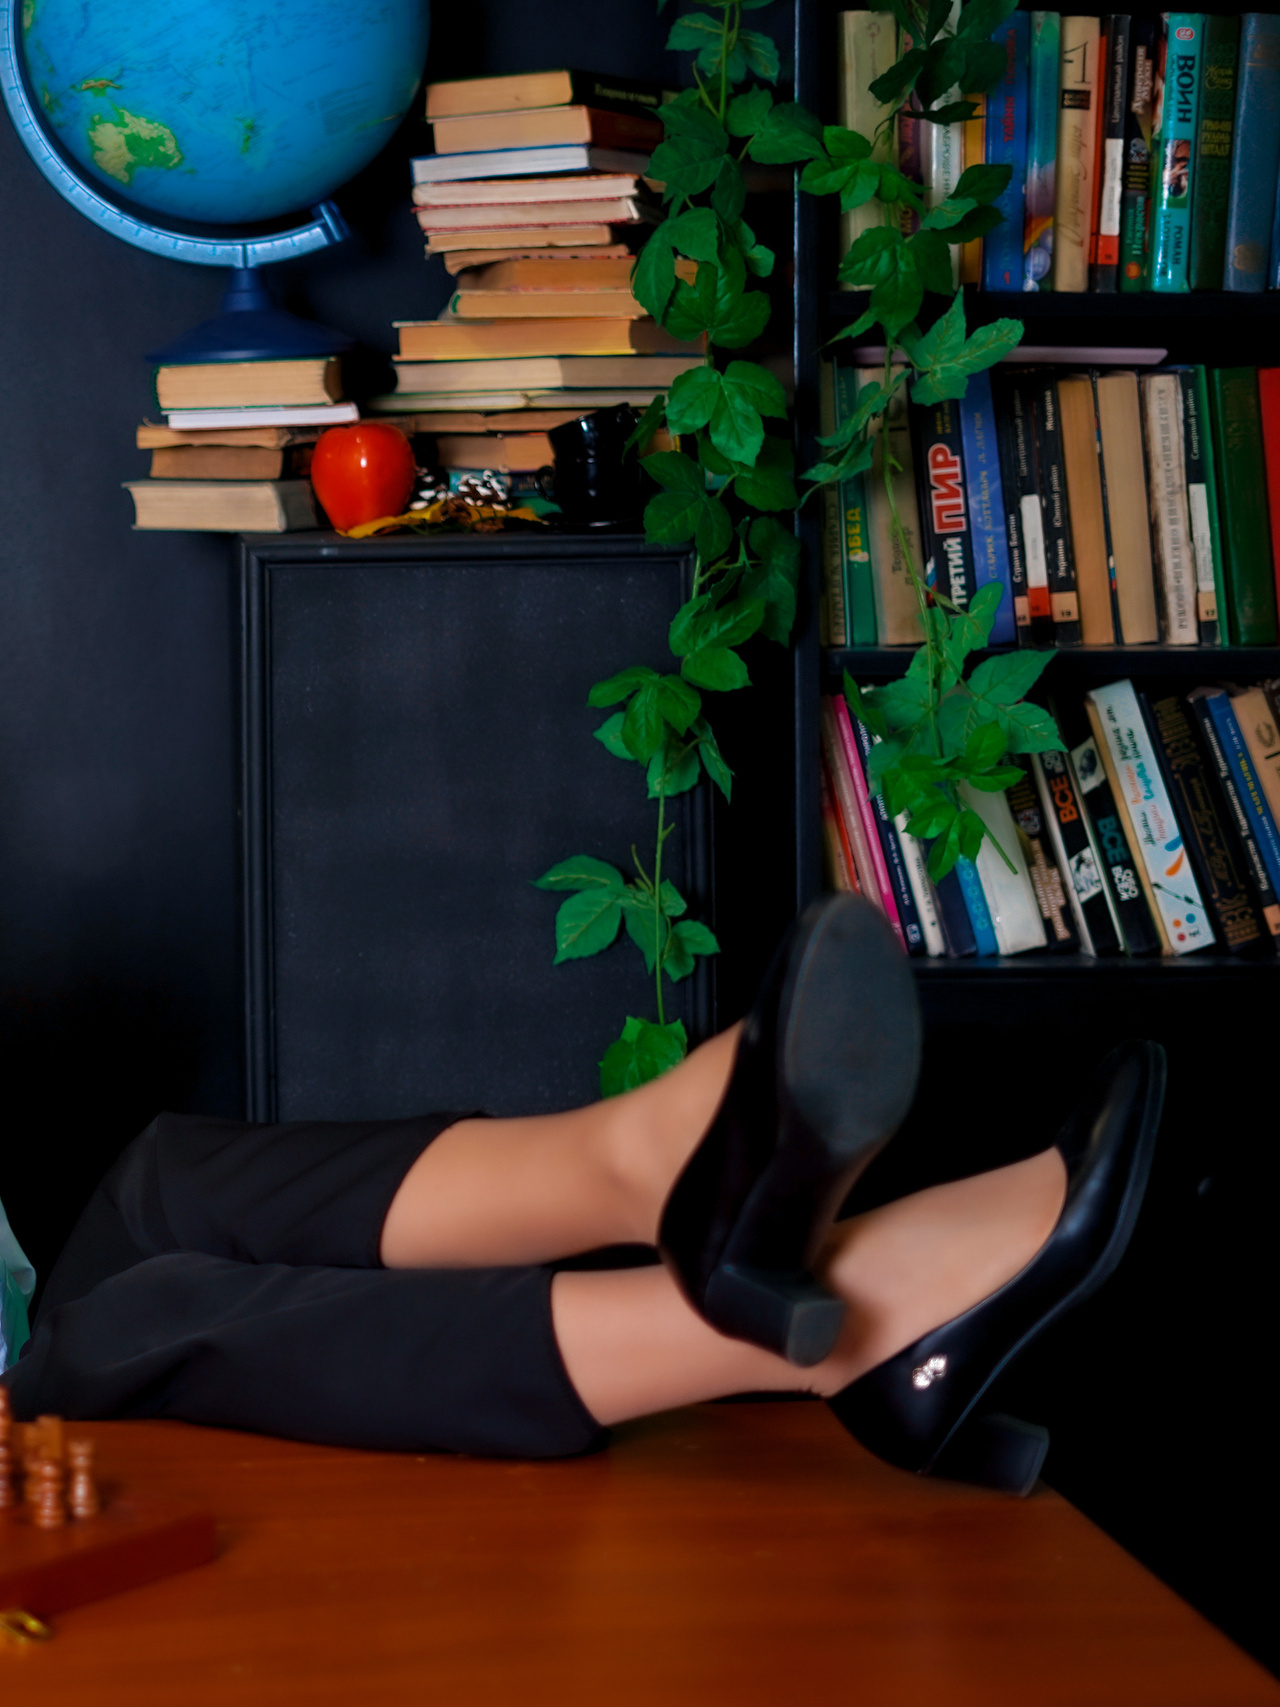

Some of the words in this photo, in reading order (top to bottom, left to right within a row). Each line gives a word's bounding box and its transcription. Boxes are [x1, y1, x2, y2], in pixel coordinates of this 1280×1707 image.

[1113, 35, 1125, 62] район
[1111, 64, 1123, 123] Центральный
[1133, 47, 1145, 113] Диверсия
[1142, 61, 1153, 99] Мухи
[1177, 54, 1195, 124] ВОИН
[1001, 96, 1015, 142] ТАЙНЫ
[1131, 196, 1144, 254] Некрасов
[1172, 225, 1184, 265] РОМАН
[1043, 389, 1055, 431] Молдова
[1186, 388, 1197, 416] район
[1188, 418, 1200, 460] Северный
[927, 442, 967, 534] ПИР
[1049, 464, 1061, 492] район
[1051, 493, 1063, 528] Южный
[943, 537, 968, 606] ТРЕТИЙ
[1011, 548, 1023, 583] Страны
[1055, 538, 1068, 579] Украина
[1052, 774, 1079, 823] ВСЕ
[1096, 815, 1129, 865] ВСЕ
